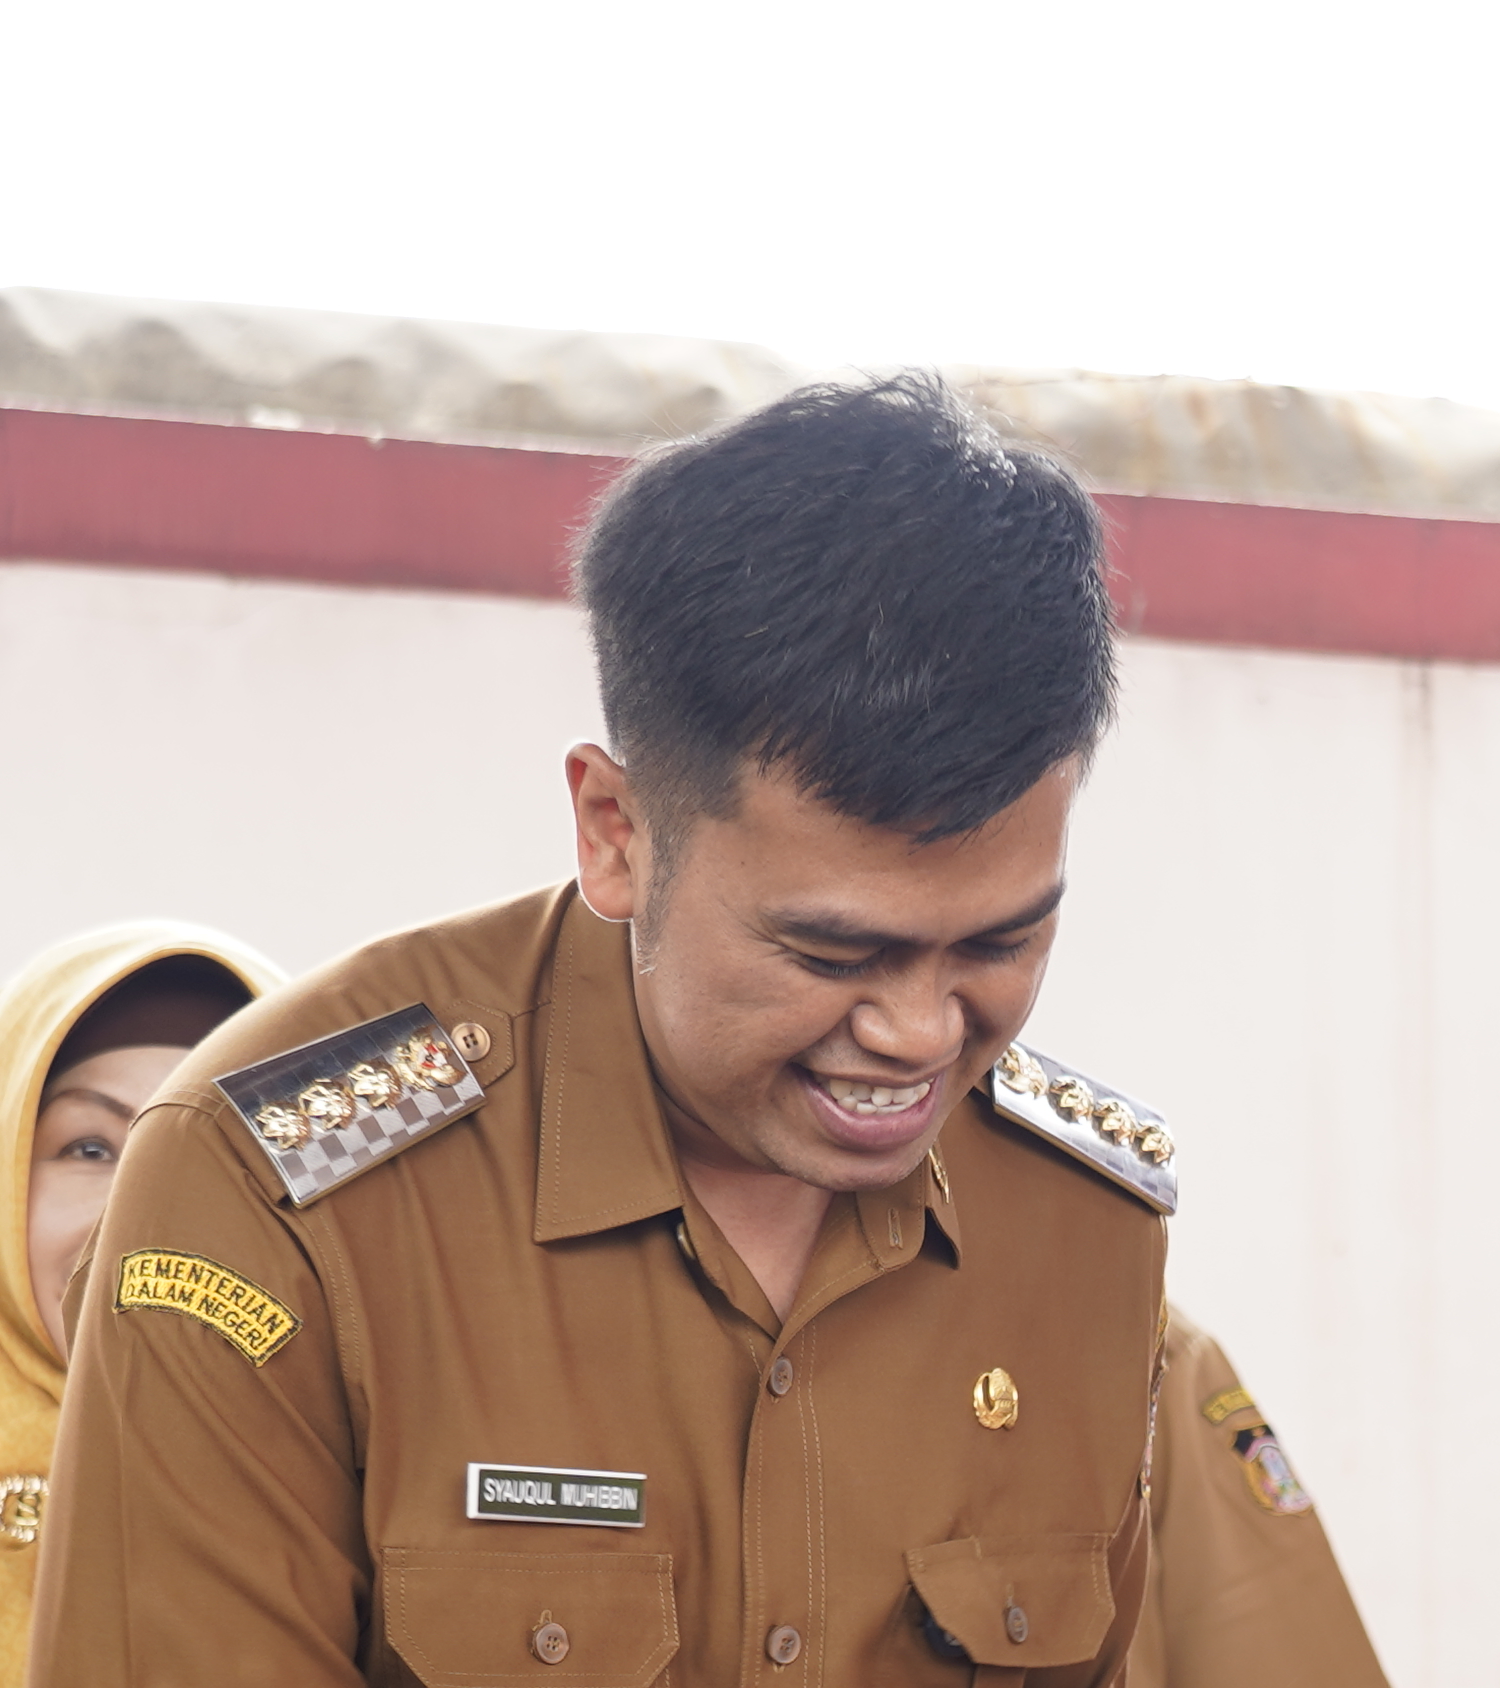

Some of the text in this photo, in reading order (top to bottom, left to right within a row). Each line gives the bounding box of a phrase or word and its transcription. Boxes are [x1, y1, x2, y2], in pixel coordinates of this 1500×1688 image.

[125, 1281, 268, 1350] DALAM NEGERI
[127, 1257, 285, 1336] KEMENTERIAN
[483, 1477, 638, 1511] SYAUQUL MUHIBBIN
